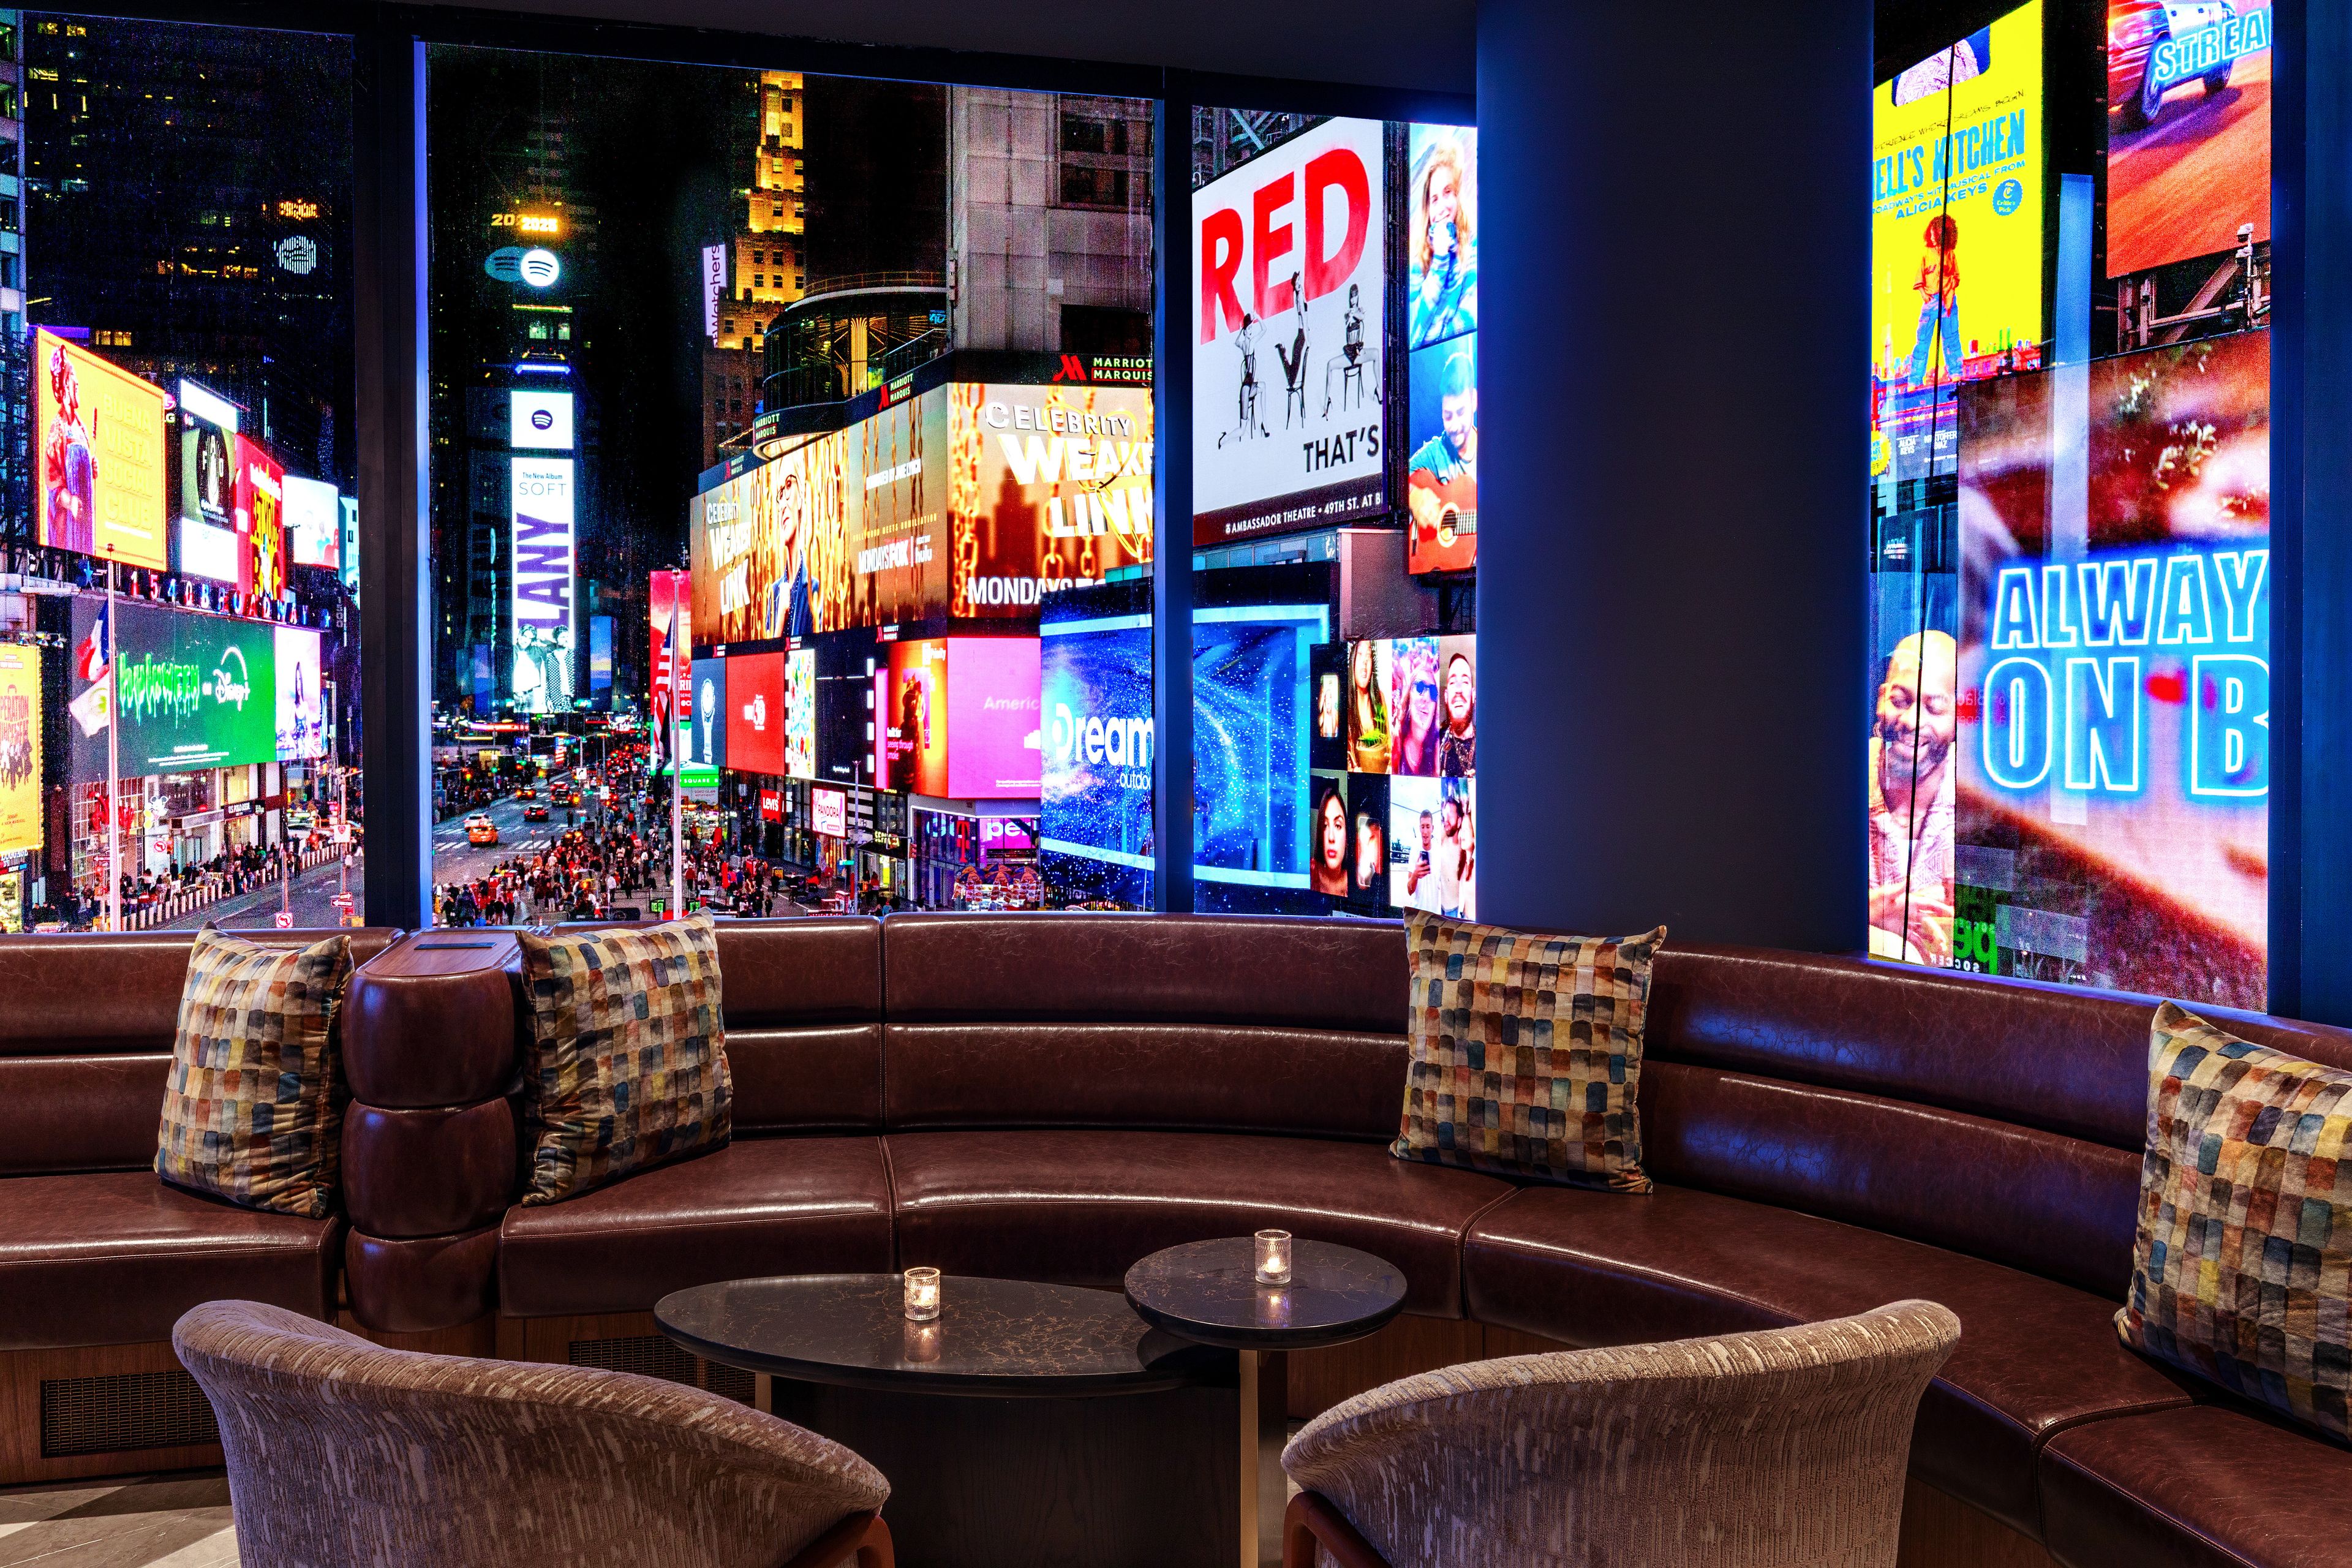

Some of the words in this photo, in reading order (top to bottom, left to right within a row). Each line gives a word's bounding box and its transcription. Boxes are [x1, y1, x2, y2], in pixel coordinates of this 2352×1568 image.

[2155, 6, 2271, 81] STREA
[1932, 108, 2025, 183] KITCHEN
[1927, 186, 1943, 197] HIT
[1947, 172, 1991, 190] MUSICAL
[1994, 160, 2026, 176] FROM
[1895, 197, 1942, 220] ALICIA
[1947, 183, 1988, 204] KEYS
[1200, 148, 1371, 345] RED
[890, 373, 913, 391] MARRIOTT
[890, 386, 910, 402] MARQUIS
[1093, 370, 1152, 380] MARQUIS
[755, 413, 780, 429] MARRIOTT
[755, 426, 776, 440] MARQUIS
[985, 402, 1131, 436] CELEBRITY
[104, 421, 152, 467] VISTA
[1303, 424, 1379, 473] THAT'S
[519, 481, 567, 496] SOFT
[707, 502, 739, 524] CELEBRITY
[853, 528, 880, 542] HOLLYWOOD
[882, 524, 898, 535] MEETS
[900, 513, 937, 530] HUMILIATION
[1232, 513, 1281, 533] AMBASSADOR
[1283, 505, 1316, 521] THEATRE
[1324, 500, 1344, 514] 49TH
[1348, 497, 1359, 510] ST.
[1362, 494, 1373, 507] AT
[1375, 492, 1382, 505] B
[516, 512, 570, 629] LANY
[859, 545, 889, 575] MONDAYS
[889, 540, 909, 569] FOX
[915, 545, 932, 564] hulu
[130, 571, 193, 606] 1540
[200, 583, 308, 626] BROADWAY
[720, 558, 751, 616] LINK
[1991, 549, 2269, 649] ALWAY
[1052, 703, 1155, 766] Dream
[1983, 655, 2140, 792] ON
